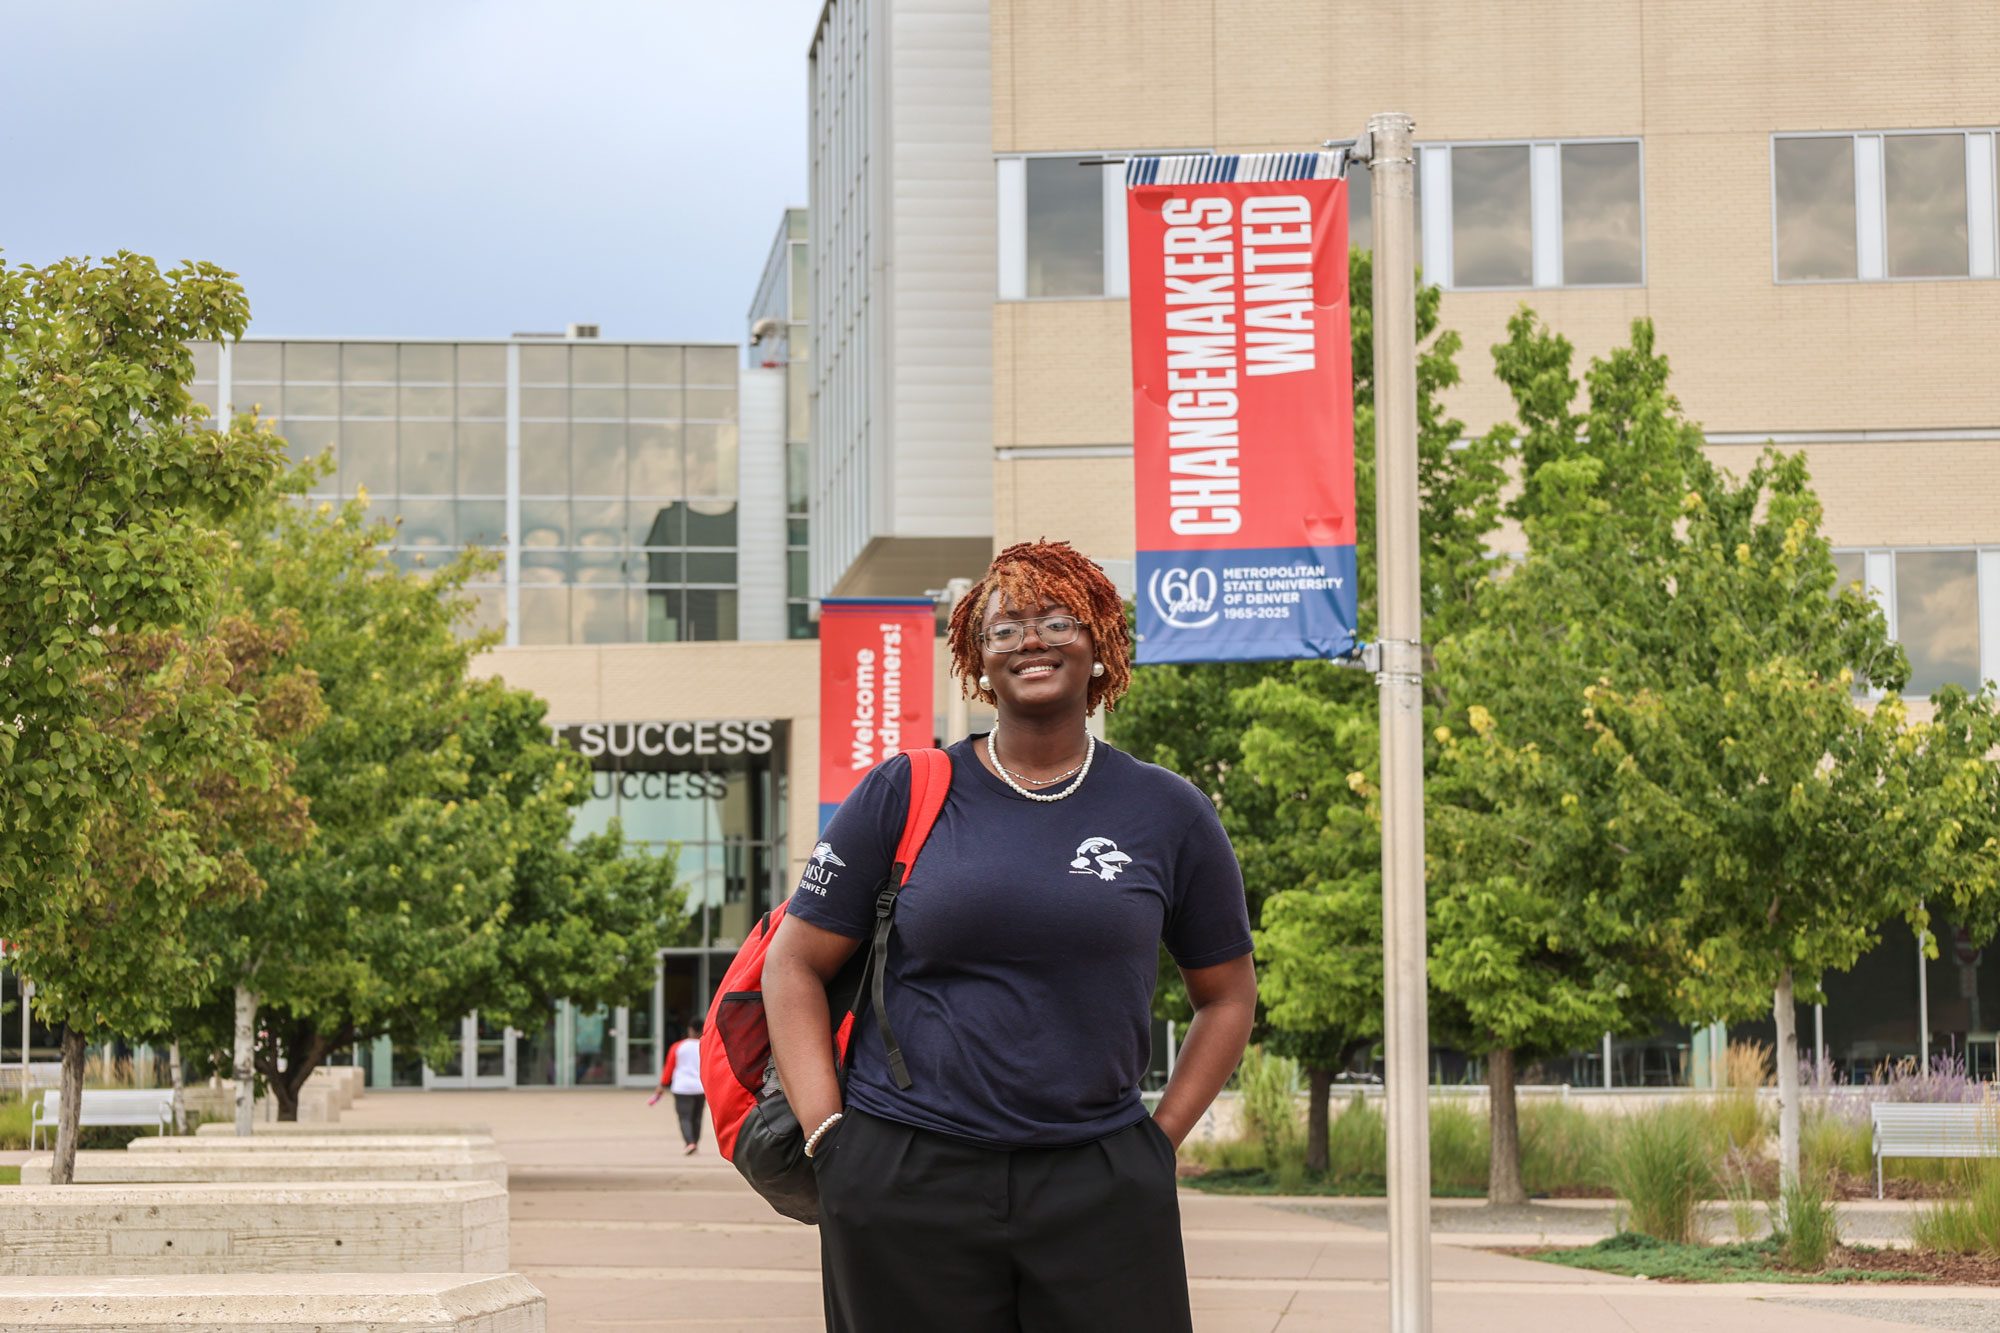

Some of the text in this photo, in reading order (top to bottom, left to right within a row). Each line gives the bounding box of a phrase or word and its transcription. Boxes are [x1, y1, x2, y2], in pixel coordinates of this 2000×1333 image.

[1241, 195, 1315, 376] WANTED
[1161, 197, 1242, 536] CHANGEMAKERS
[1161, 567, 1217, 605] 60
[1223, 566, 1325, 579] METROPOLITAN
[1223, 578, 1343, 592] STATE UNIVERSITY
[1223, 592, 1300, 605] OF DENVER
[1223, 607, 1290, 619] 1965-2025
[877, 623, 902, 761] adrunners!
[851, 648, 875, 770] Welcome
[579, 719, 773, 756] SUCCESS
[592, 771, 728, 800] UCCESS
[804, 864, 834, 885] MSU
